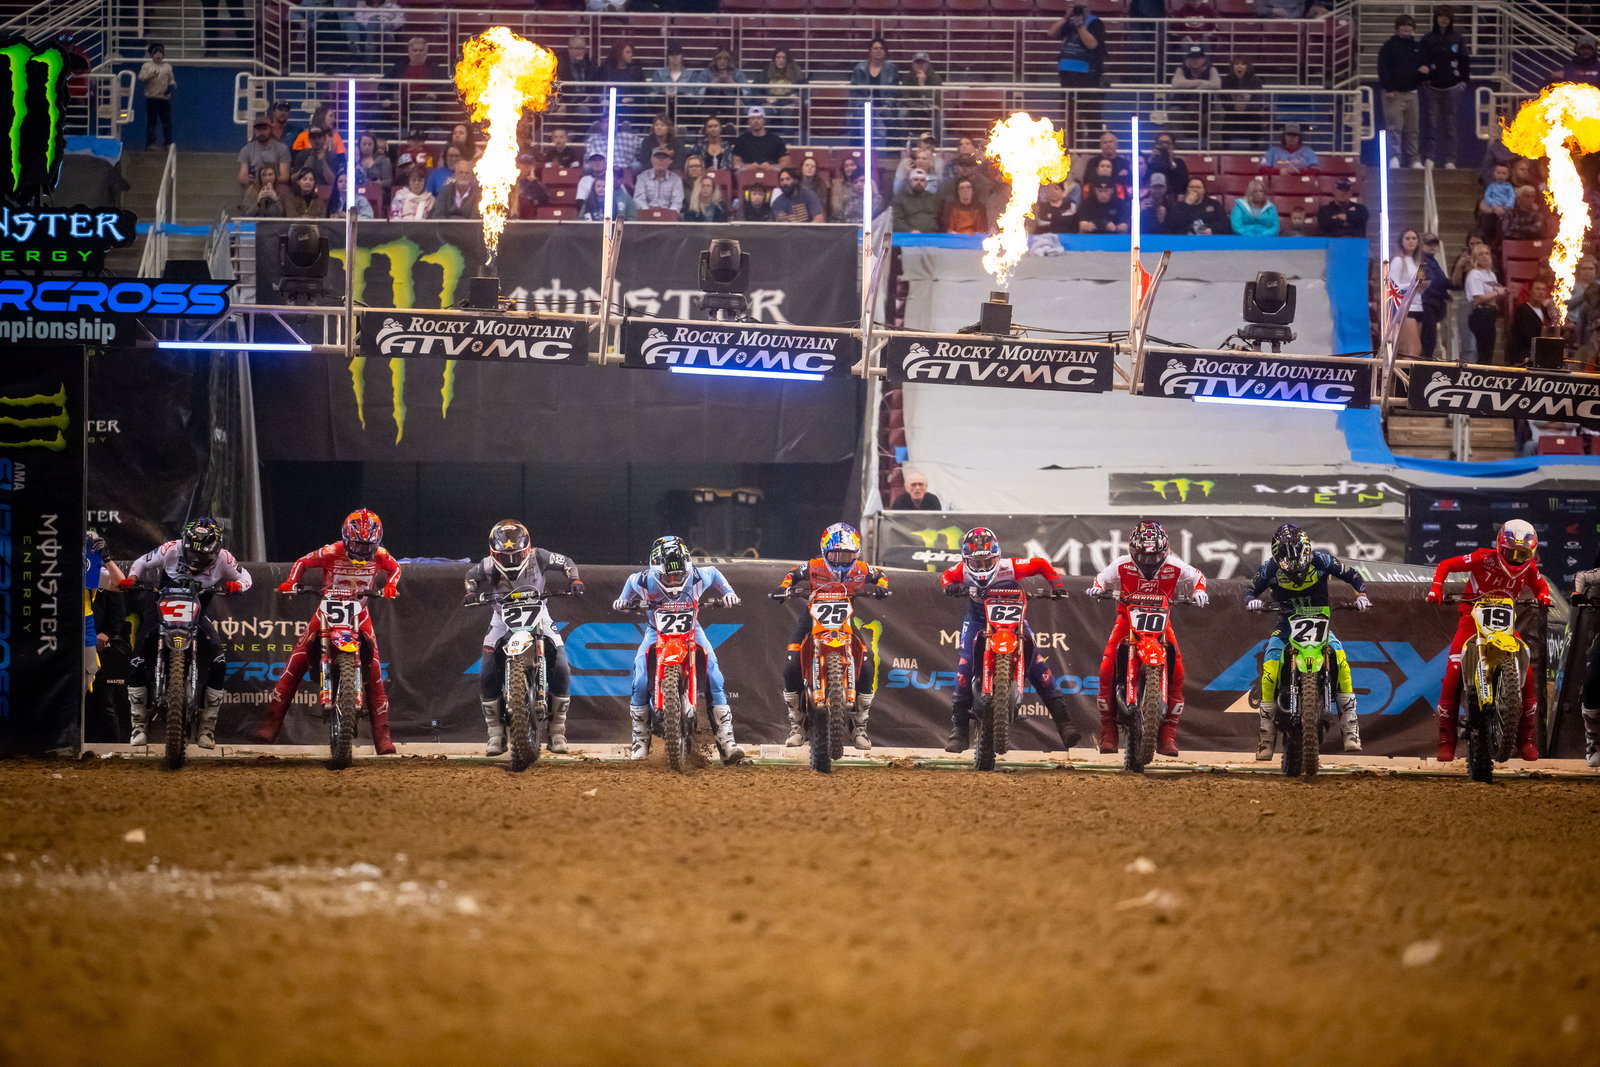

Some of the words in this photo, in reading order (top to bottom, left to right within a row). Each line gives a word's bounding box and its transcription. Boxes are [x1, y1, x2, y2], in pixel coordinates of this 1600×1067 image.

[407, 317, 470, 334] ROCKY
[473, 319, 574, 339] MOUNTAIN
[672, 327, 735, 345] ROCKY
[736, 331, 838, 350] MOUNTAIN
[934, 342, 997, 359] ROCKY
[998, 345, 1099, 364] MOUNTAIN
[1191, 358, 1253, 375] ROCKY
[1255, 361, 1357, 382] MOUNTAIN
[1455, 371, 1518, 390] ROCKY
[13, 462, 25, 492] AMA
[23, 535, 32, 633] ENERGY
[37, 514, 62, 655] MONSTER
[163, 601, 193, 621] 3
[327, 602, 355, 625] 51
[504, 607, 541, 628] 27
[817, 604, 849, 624] 25
[990, 606, 1022, 622] 62
[1482, 609, 1511, 627] 19
[660, 614, 693, 634] 23
[1136, 613, 1165, 632] 10
[1294, 620, 1327, 642] 21
[892, 658, 918, 669] AMA
